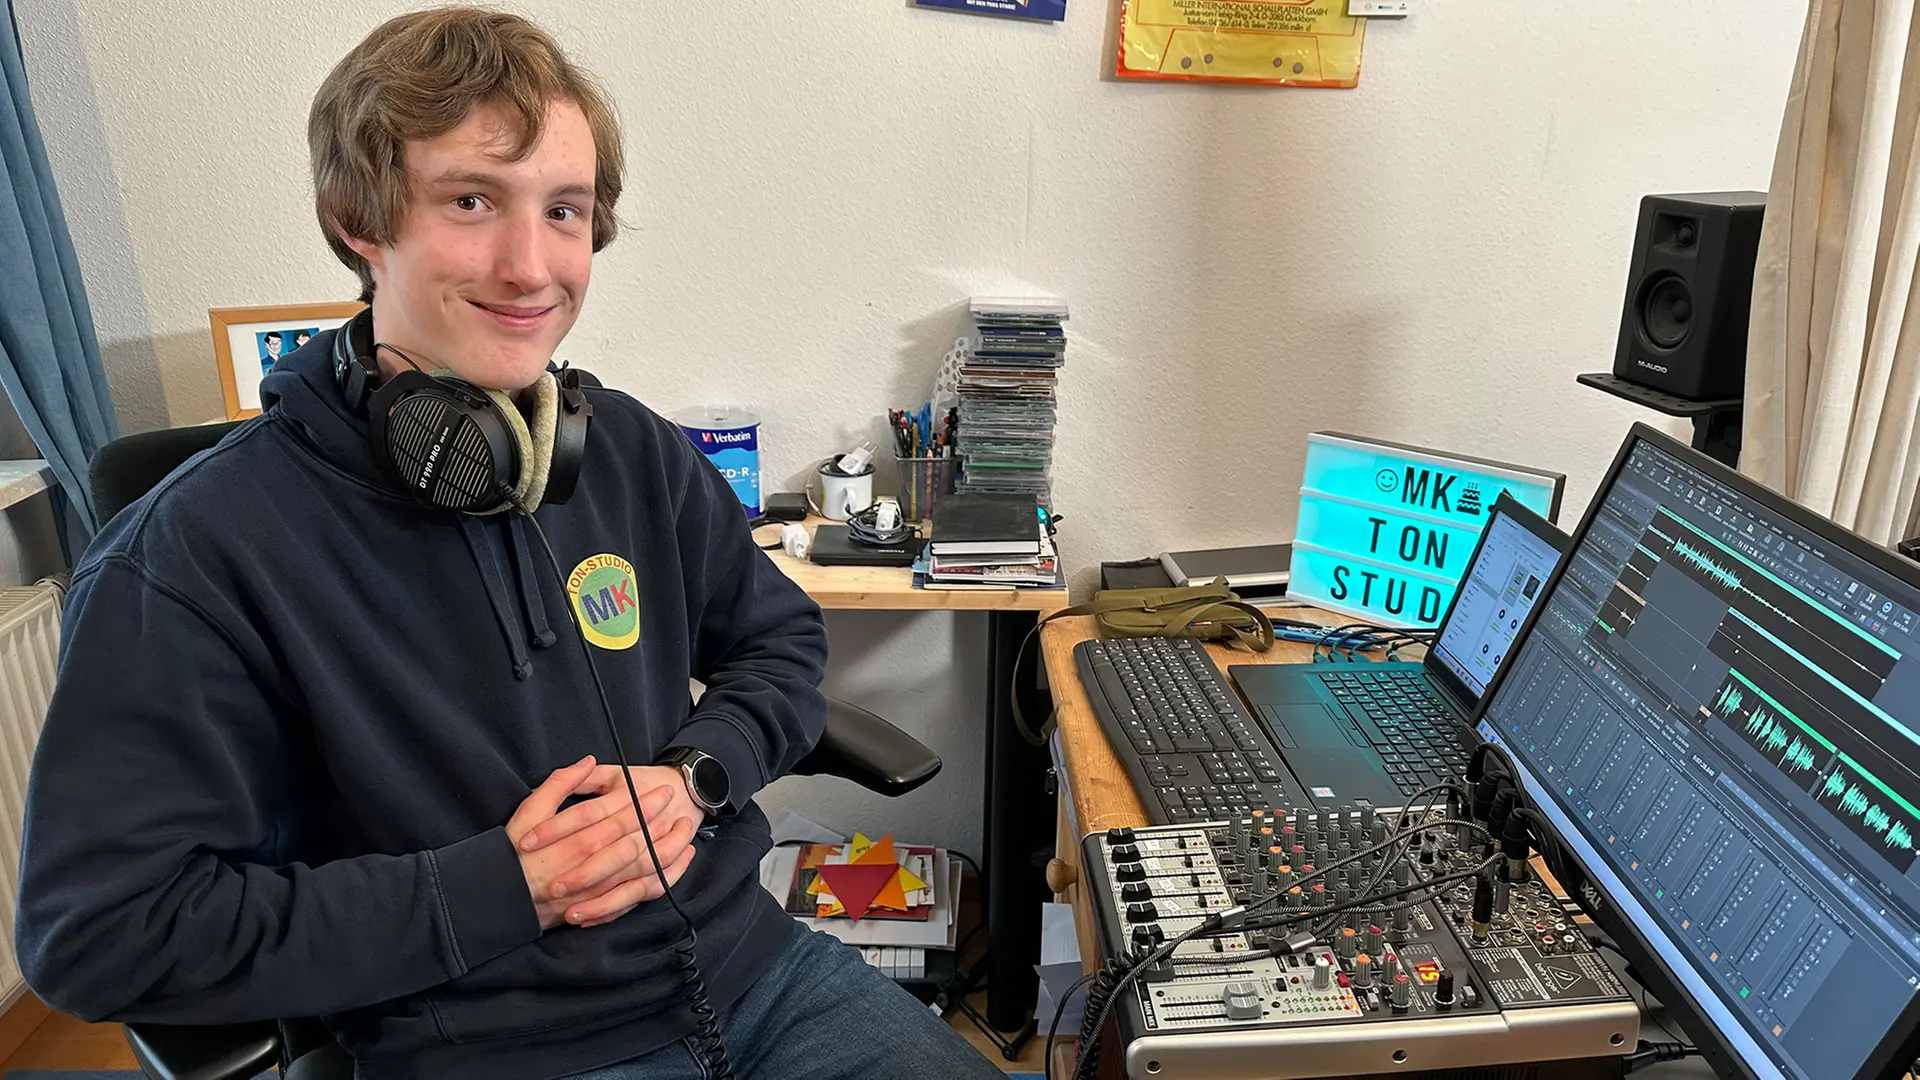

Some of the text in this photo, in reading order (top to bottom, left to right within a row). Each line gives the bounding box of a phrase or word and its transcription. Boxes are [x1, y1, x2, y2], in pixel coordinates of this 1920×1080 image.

[1197, 2, 1250, 11] INTERNATIONAL
[1253, 4, 1304, 14] SCHALLPLATTEN
[1637, 360, 1668, 374] M-AUDIO
[712, 431, 751, 444] Verbatim
[420, 444, 440, 489] DT 990 PRO
[1402, 467, 1457, 513] MK
[568, 556, 632, 594] TON-STUDIO
[581, 578, 636, 625] MK
[1580, 879, 1602, 910] DELL
[1534, 962, 1560, 994] behringer
